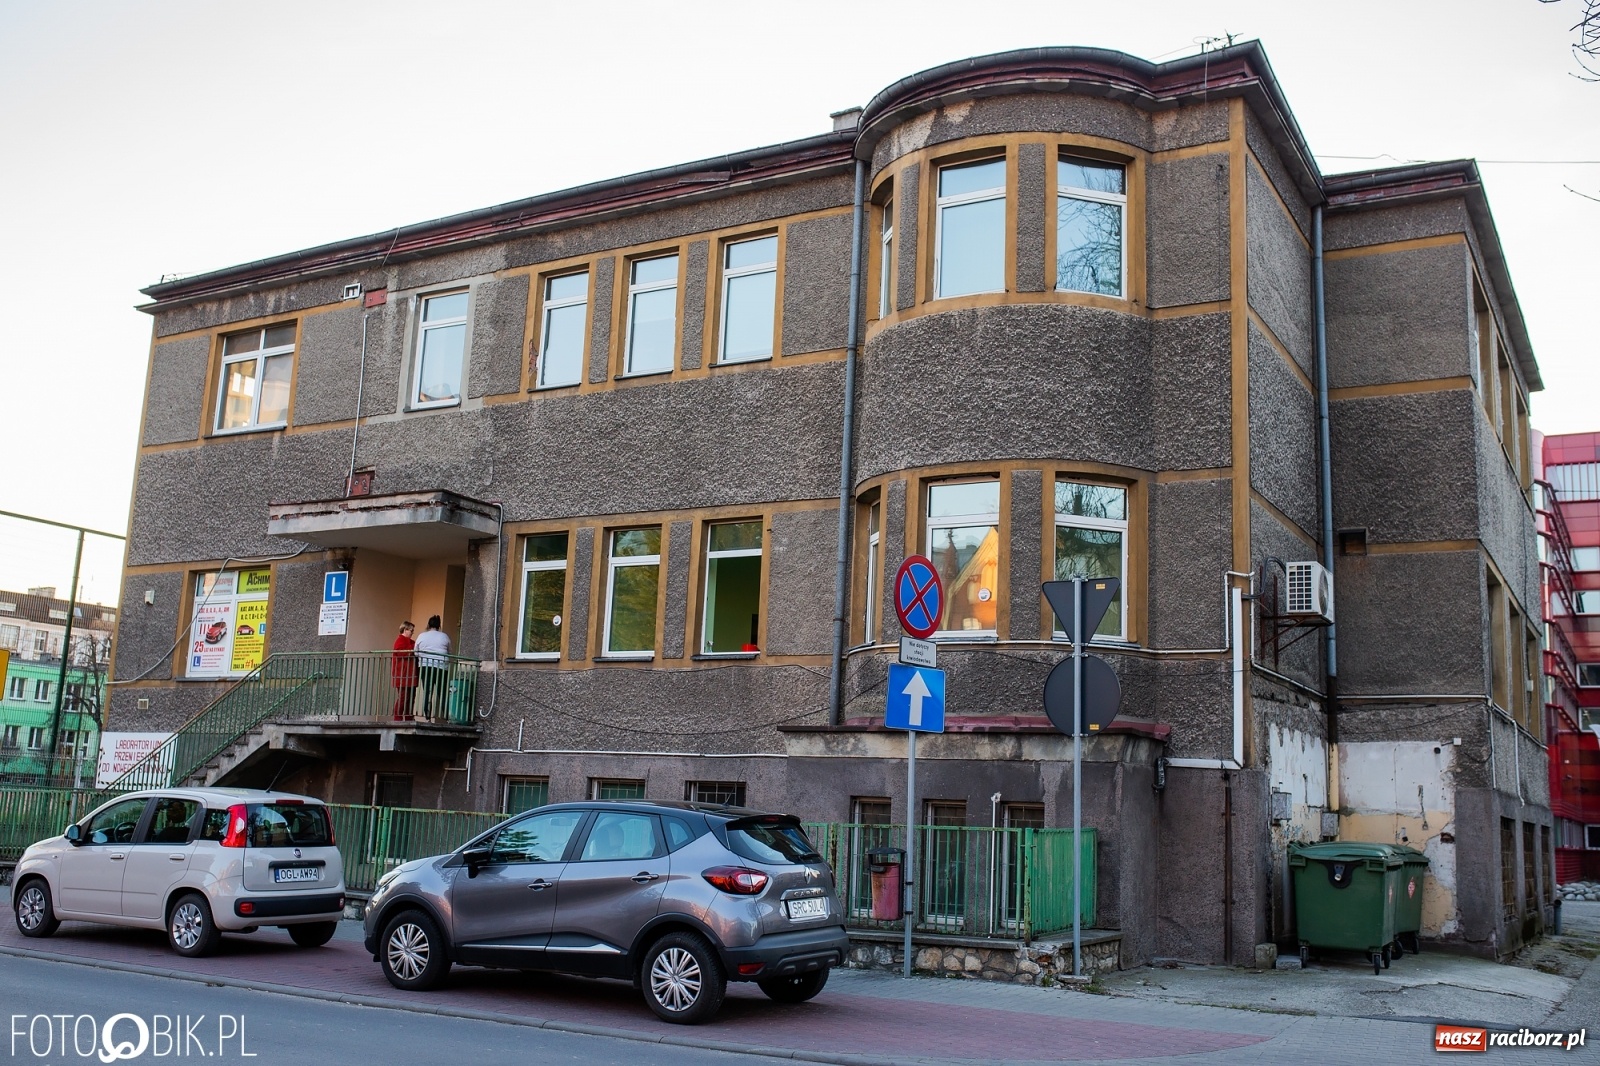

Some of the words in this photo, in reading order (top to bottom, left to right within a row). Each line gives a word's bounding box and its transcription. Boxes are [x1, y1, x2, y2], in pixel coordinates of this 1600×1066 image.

[331, 577, 341, 597] L
[194, 641, 204, 653] 25
[115, 740, 162, 750] LABORATORIUM
[102, 763, 110, 772] DO
[281, 869, 297, 879] OGL
[792, 901, 808, 914] SRC
